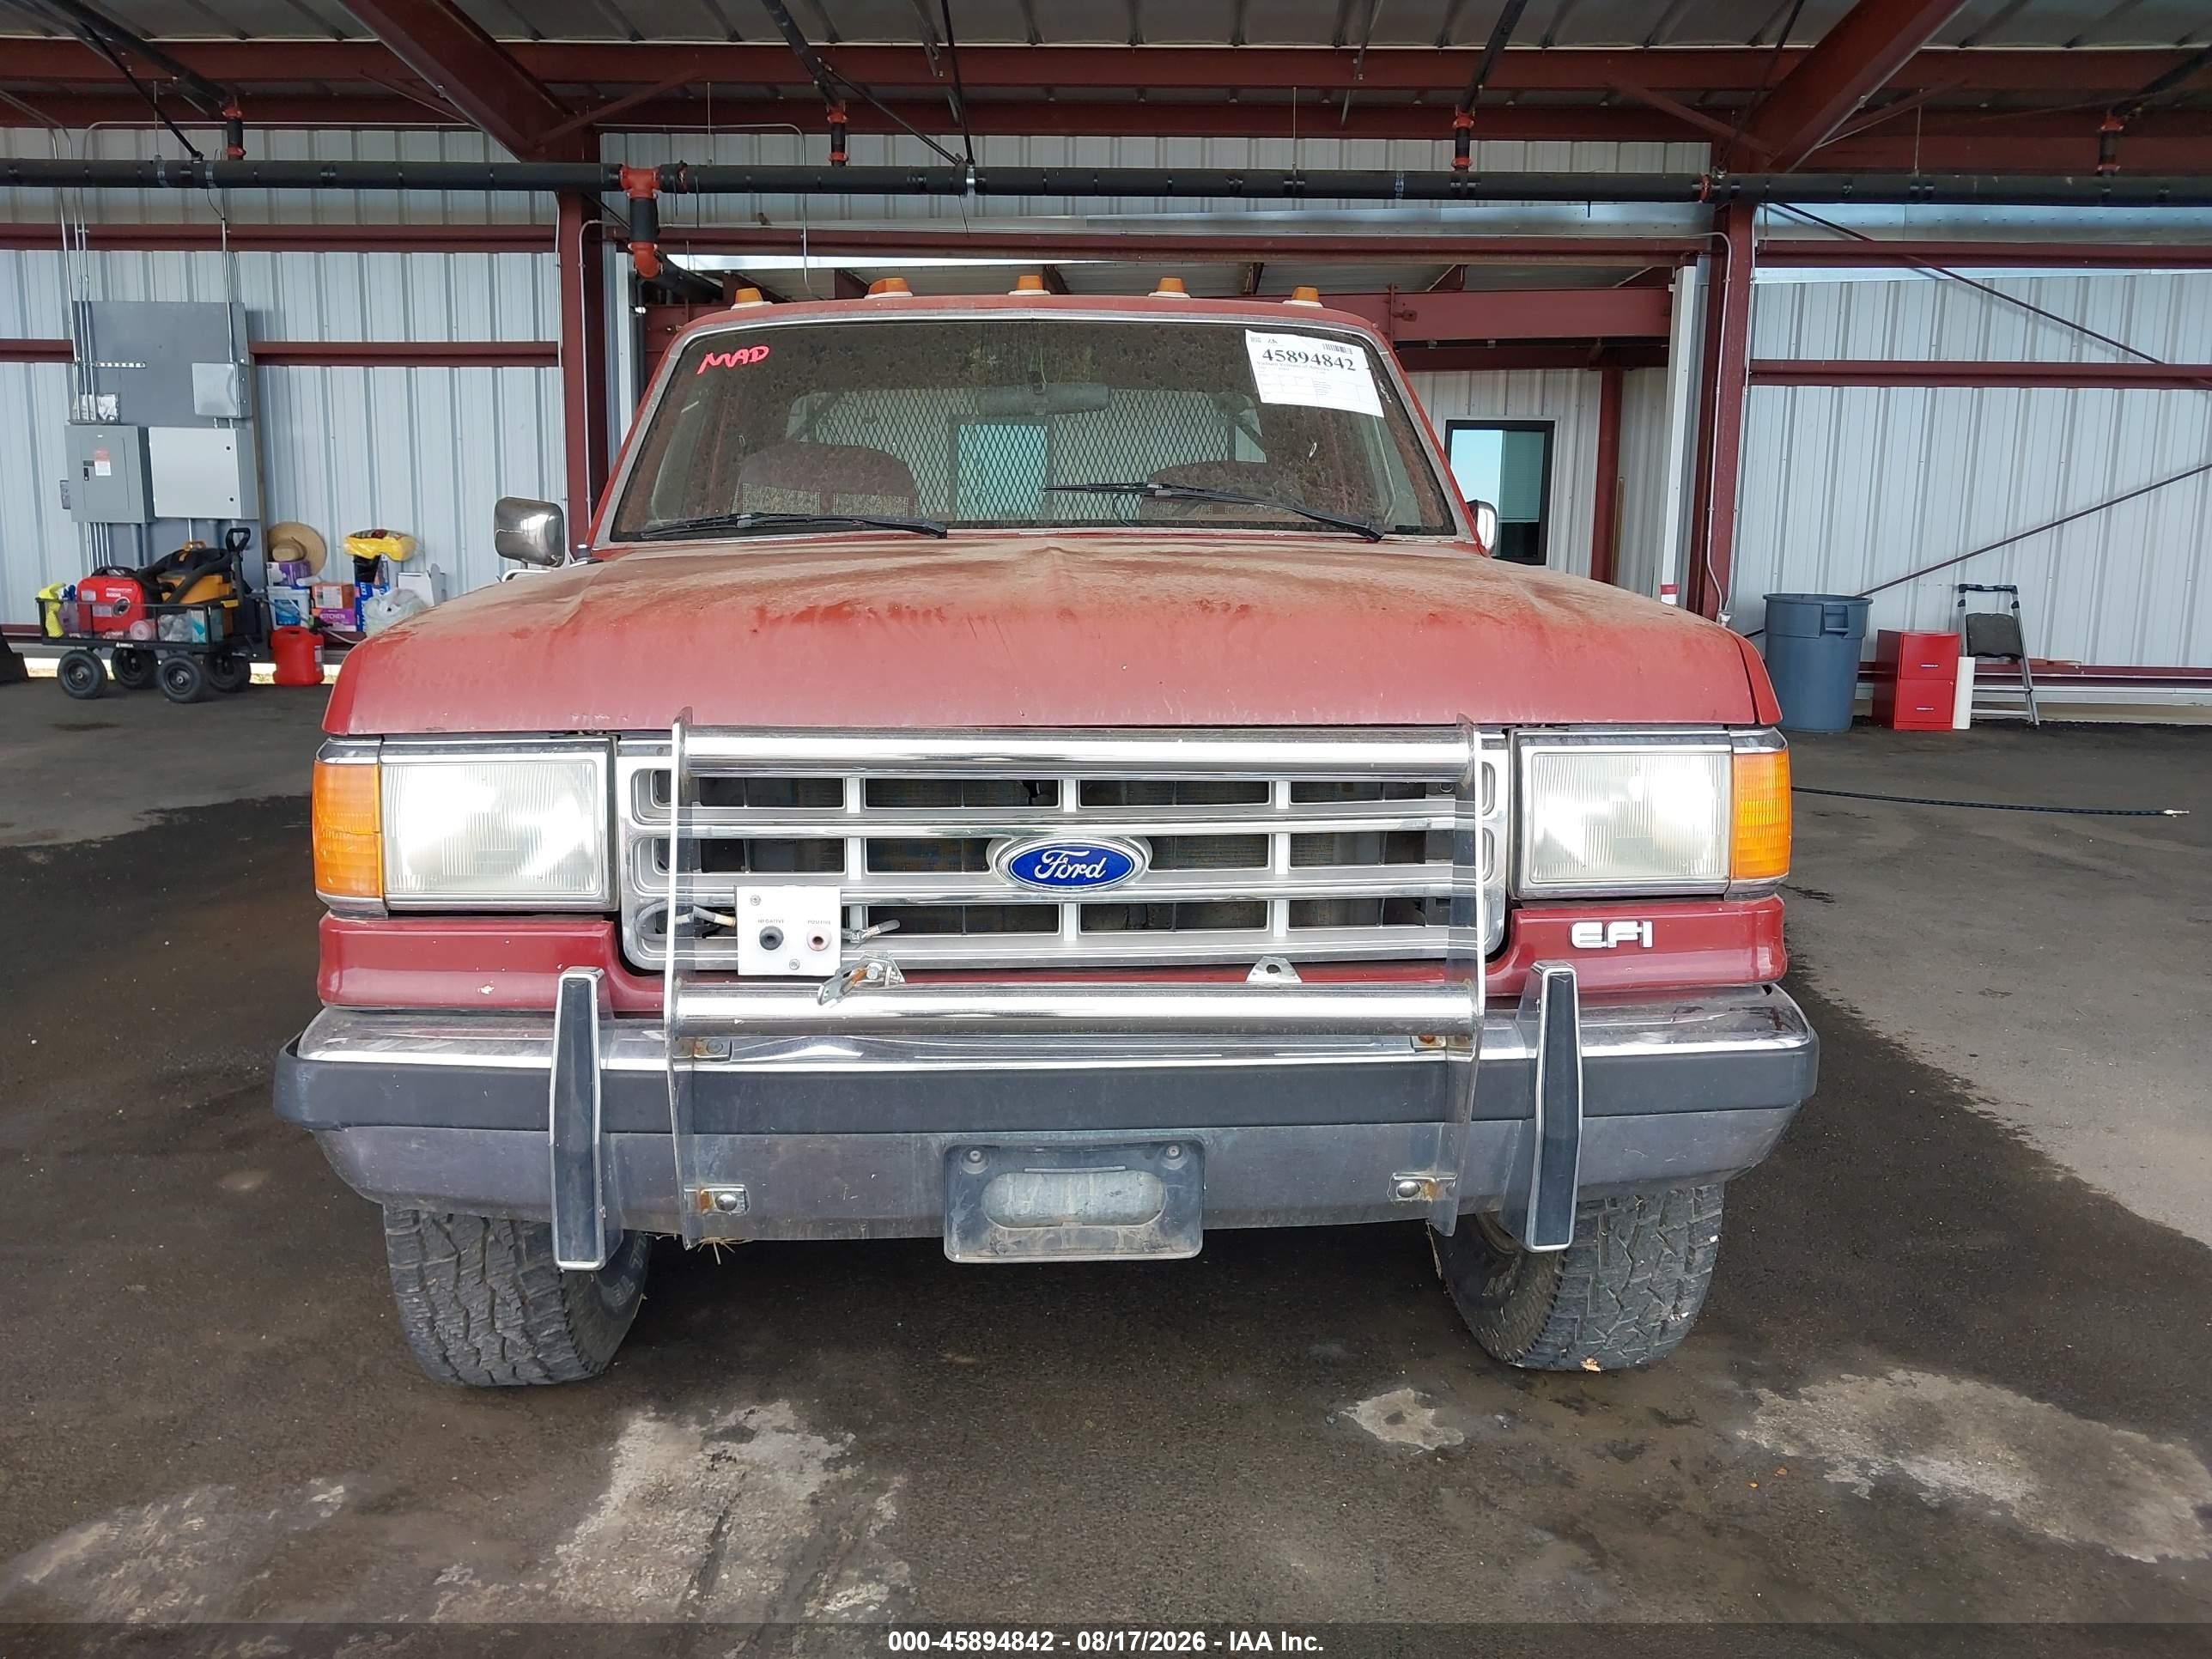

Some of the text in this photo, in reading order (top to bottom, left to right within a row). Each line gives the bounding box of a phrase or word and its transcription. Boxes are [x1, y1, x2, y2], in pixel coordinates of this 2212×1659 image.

[696, 345, 769, 374] MAD
[1262, 349, 1356, 371] 45894842
[1034, 849, 1107, 879] Ford
[1571, 921, 1653, 949] EFI
